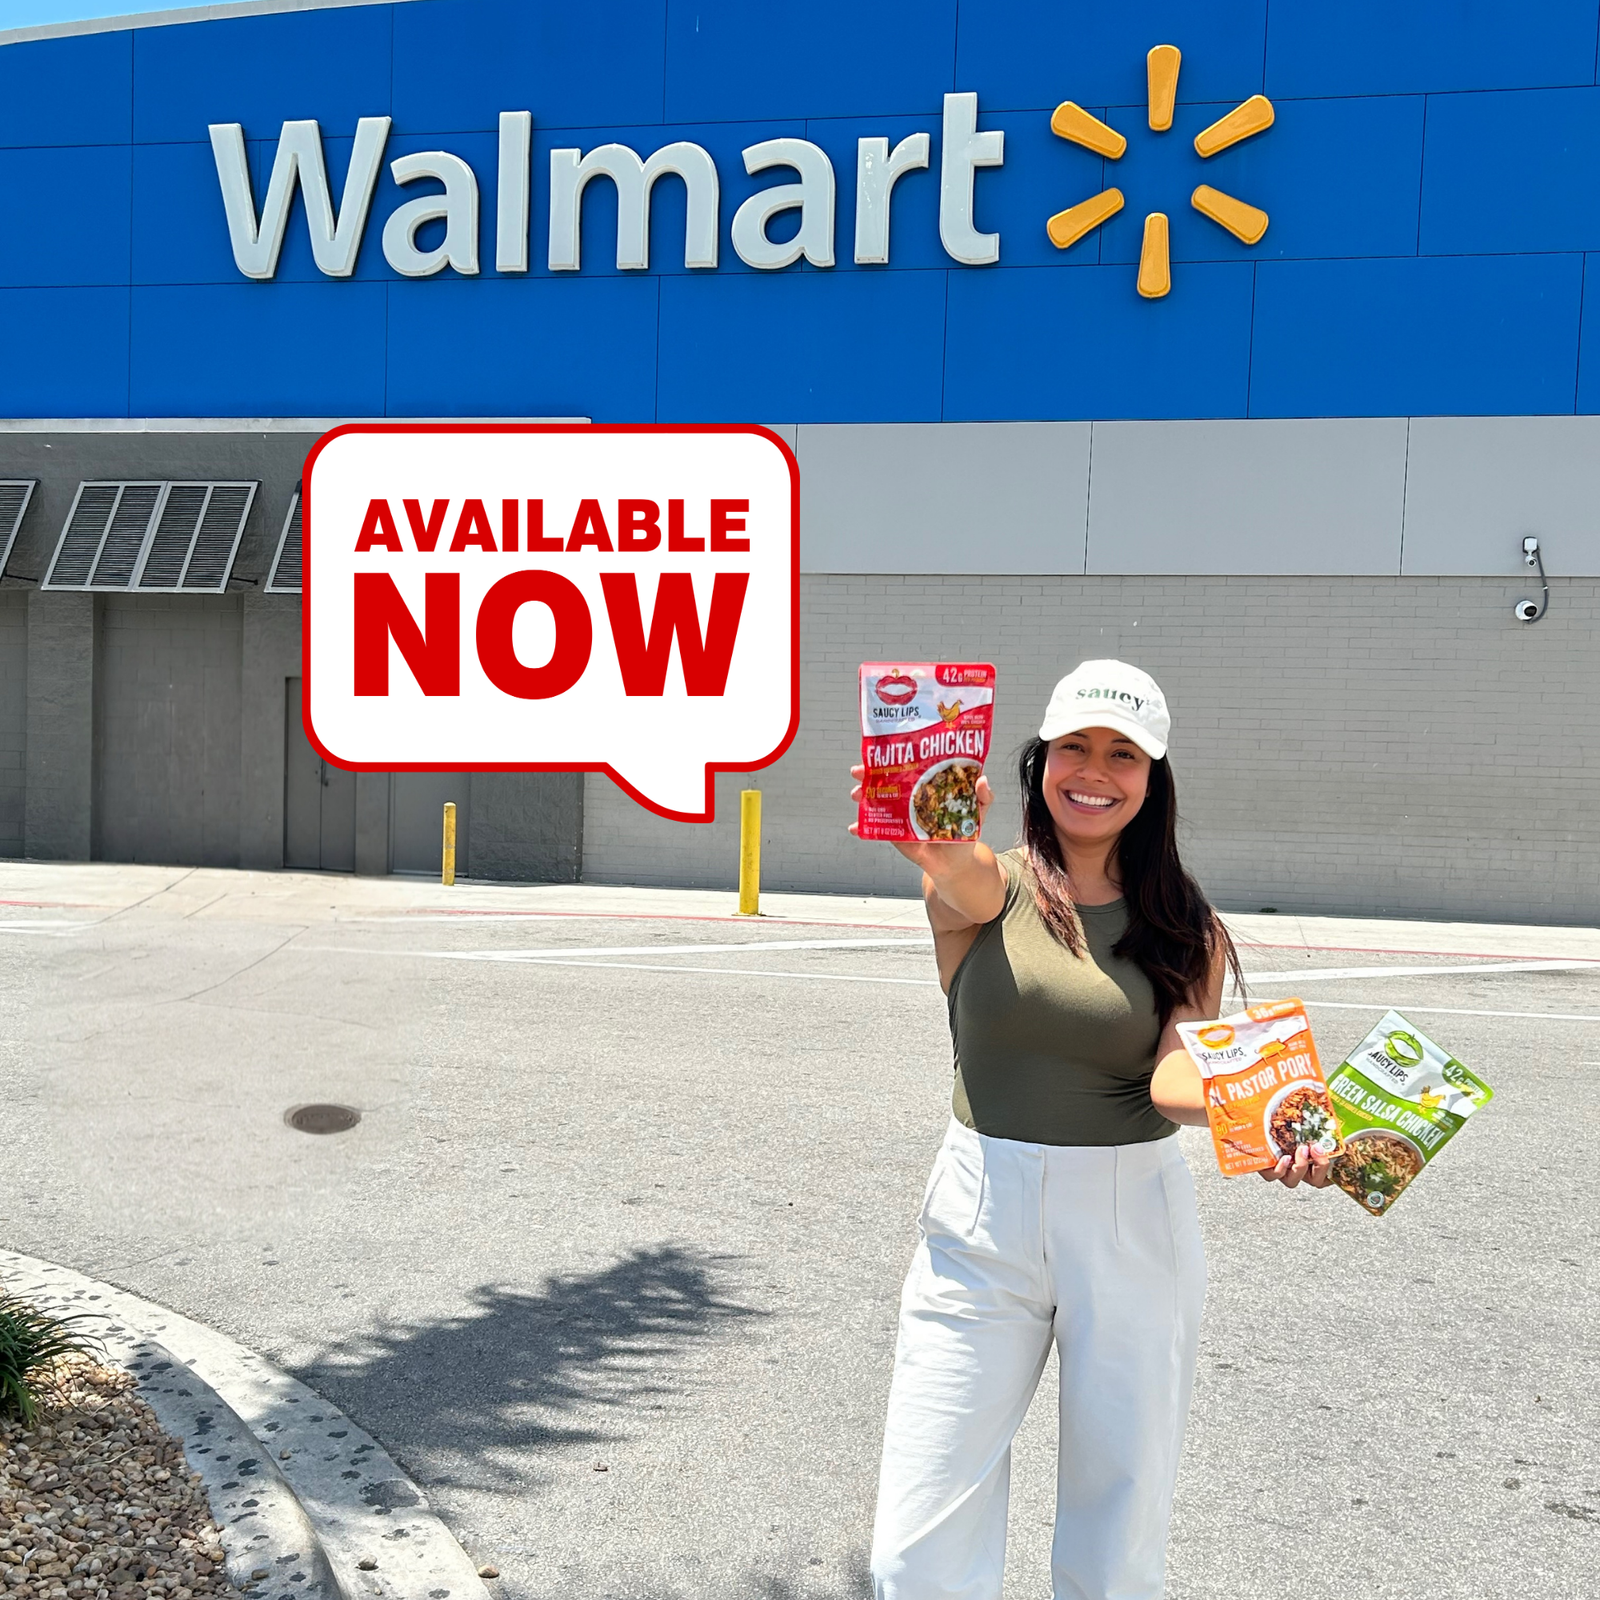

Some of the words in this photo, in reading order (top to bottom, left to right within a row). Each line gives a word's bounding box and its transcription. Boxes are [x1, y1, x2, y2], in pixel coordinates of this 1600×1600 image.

[208, 91, 1005, 280] Walmart
[963, 669, 987, 678] PROTEIN
[872, 707, 900, 718] SAUCY
[1075, 688, 1145, 712] saucy
[866, 741, 915, 768] FAJITA
[919, 729, 985, 759] CHICKEN
[1201, 1051, 1224, 1061] SAUCY
[1208, 1085, 1226, 1108] AL
[1225, 1066, 1278, 1101] PASTOR
[1277, 1053, 1317, 1081] PORK
[1328, 1073, 1368, 1106] GREEN
[1360, 1095, 1403, 1122] SALSA
[1396, 1110, 1446, 1151] CHICKEN
